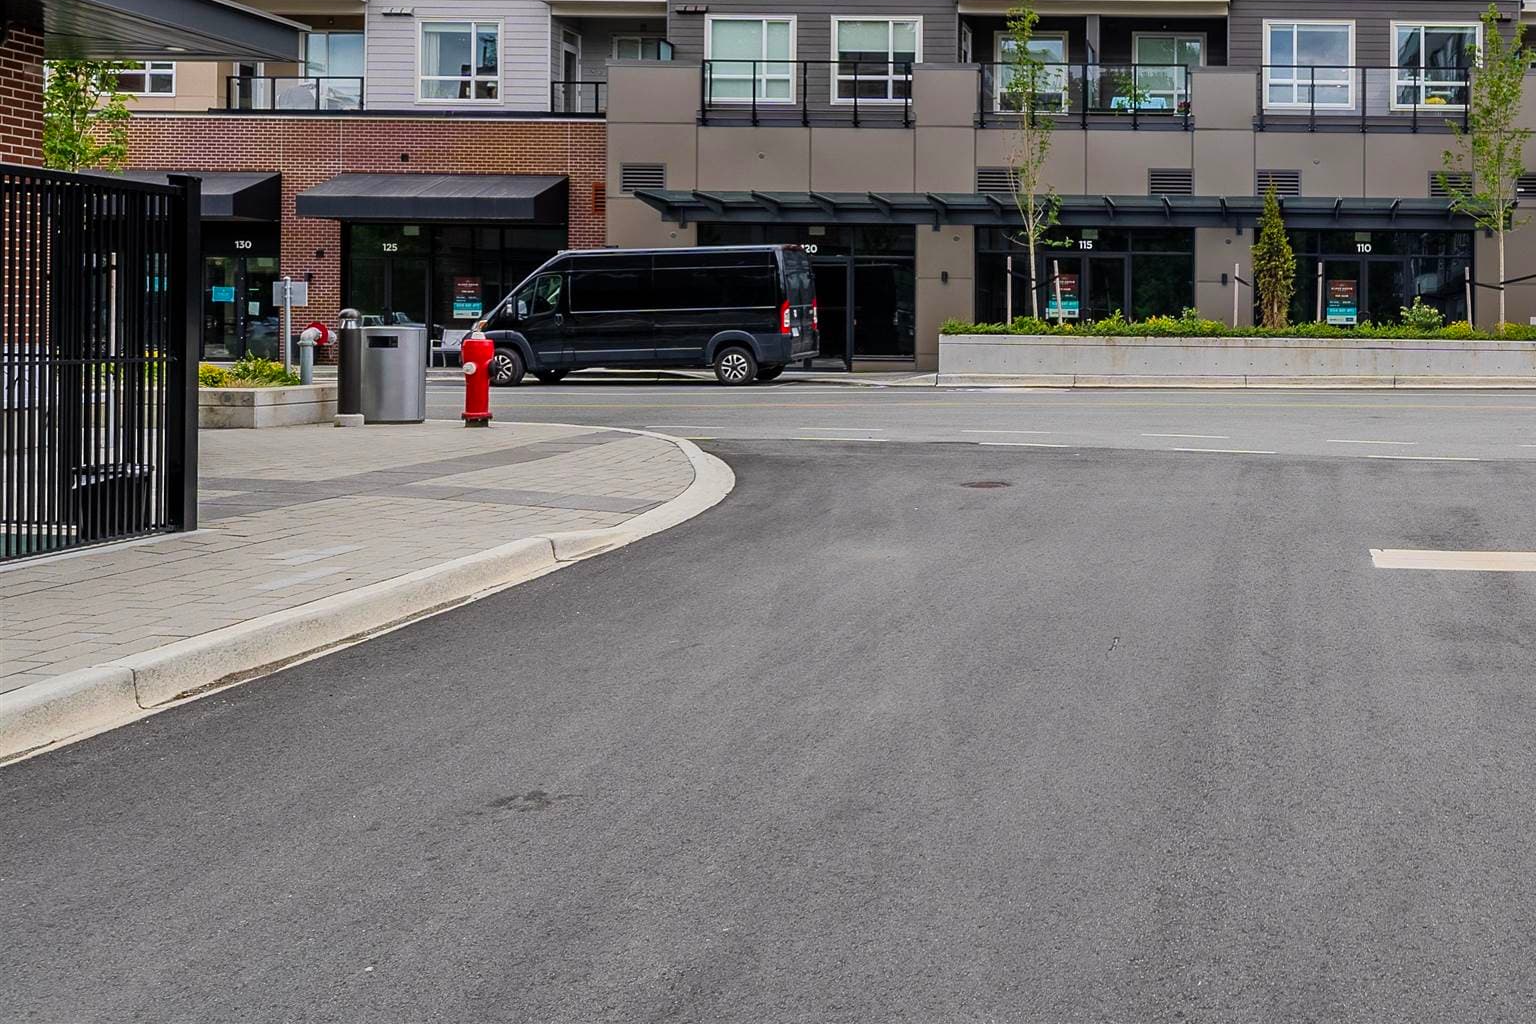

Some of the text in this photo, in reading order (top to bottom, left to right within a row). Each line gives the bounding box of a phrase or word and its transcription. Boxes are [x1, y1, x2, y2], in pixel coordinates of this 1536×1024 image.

[234, 240, 252, 249] 130
[382, 243, 398, 252] 125
[1079, 240, 1093, 250] 115
[1356, 243, 1372, 253] 110
